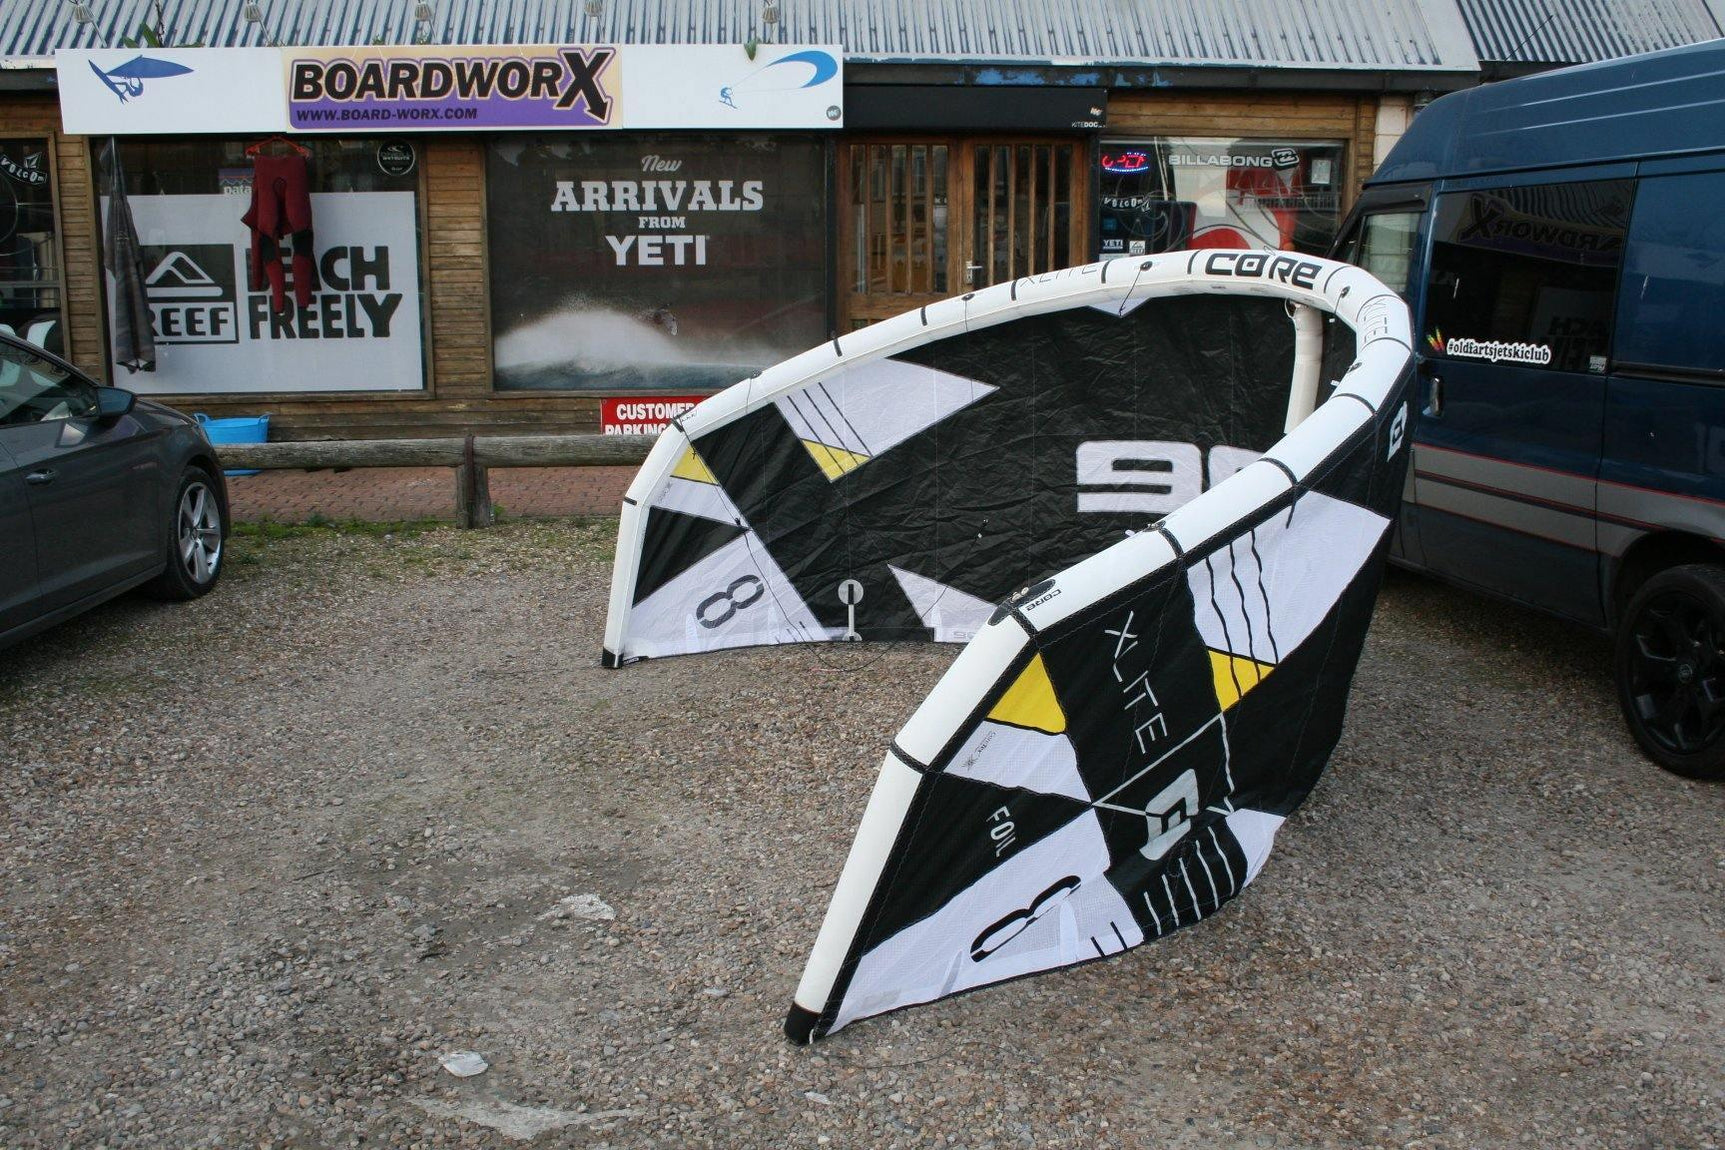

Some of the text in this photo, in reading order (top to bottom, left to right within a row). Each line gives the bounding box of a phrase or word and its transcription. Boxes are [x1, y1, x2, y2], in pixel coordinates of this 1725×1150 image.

[293, 52, 610, 121] BOARDWORX
[297, 107, 478, 121] WWW.BOARD-WORX.COM
[641, 154, 682, 172] New
[1168, 154, 1273, 168] BILLABONG
[550, 180, 764, 212] ARRIVALS
[638, 216, 686, 229] FROM
[605, 235, 707, 266] YETI
[248, 293, 403, 340] FREELY
[1448, 340, 1550, 363] #oldfartsjetskiclub
[985, 805, 1017, 859] FOIL
